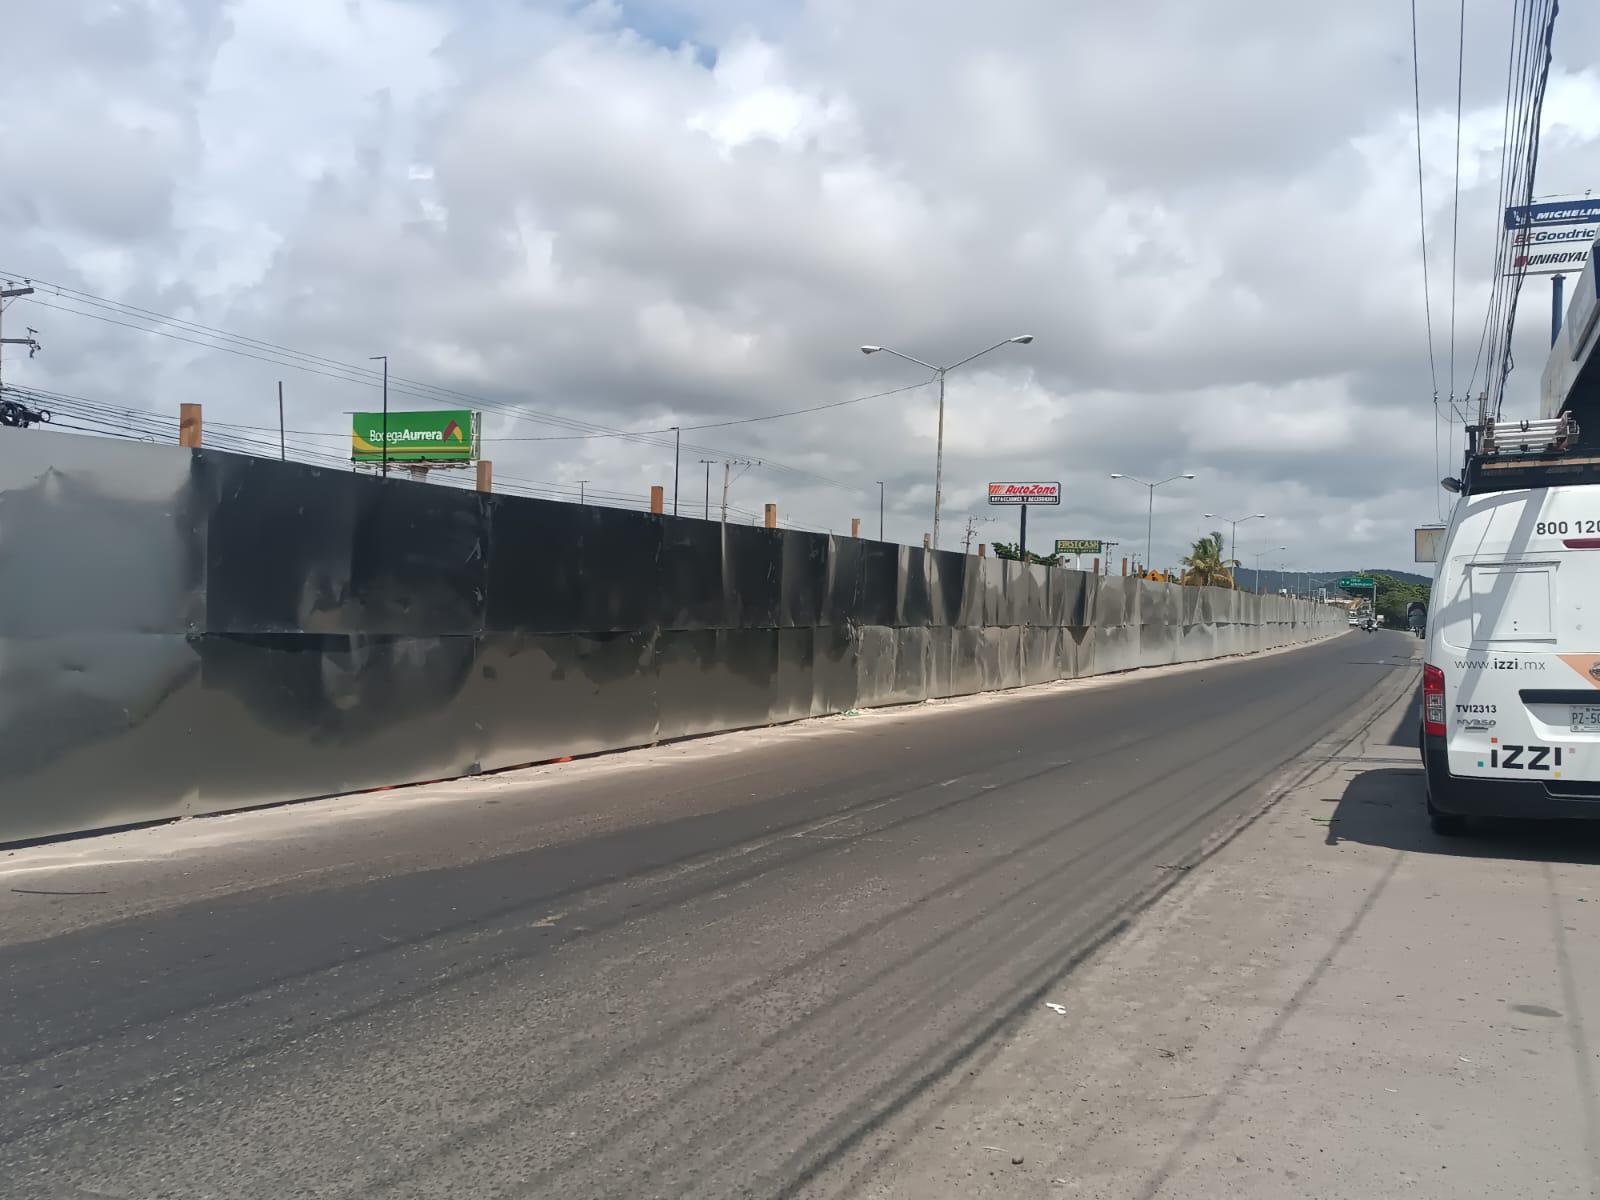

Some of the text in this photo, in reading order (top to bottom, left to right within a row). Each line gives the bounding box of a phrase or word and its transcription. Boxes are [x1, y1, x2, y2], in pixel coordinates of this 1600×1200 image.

[1536, 208, 1600, 219] MICHELIN
[1528, 252, 1588, 265] UNIROYAL
[1005, 485, 1057, 495] AutoZone
[1536, 522, 1568, 535] 800
[1455, 658, 1546, 671] www.izzi.mx
[1456, 704, 1497, 713] TVI2313
